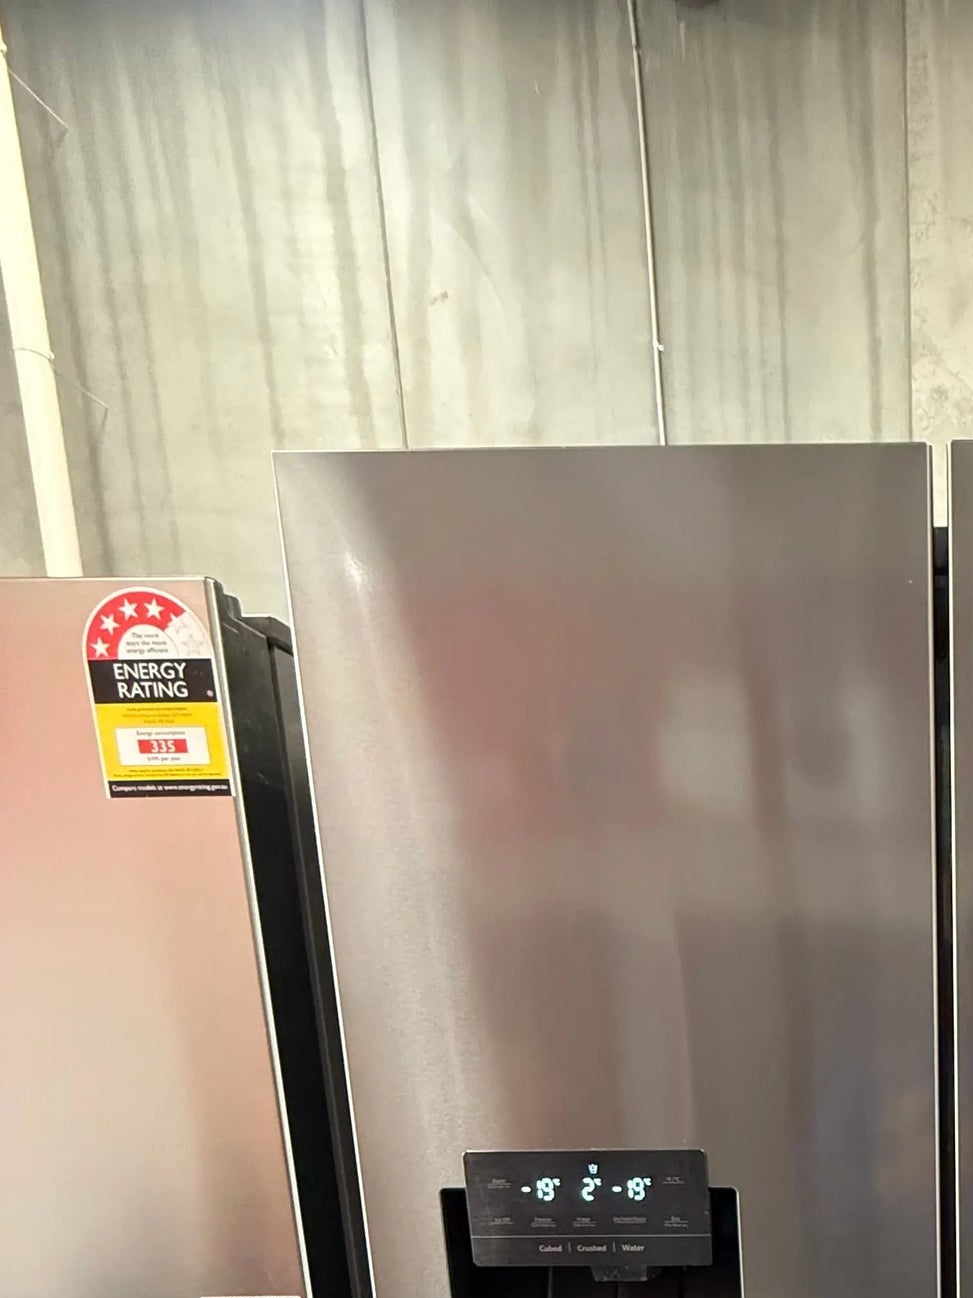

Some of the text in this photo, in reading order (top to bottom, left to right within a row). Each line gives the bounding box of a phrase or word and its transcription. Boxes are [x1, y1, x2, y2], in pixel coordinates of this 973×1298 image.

[113, 662, 186, 680] ENERGY
[117, 681, 189, 699] RATING
[150, 740, 176, 753] 335
[539, 1244, 645, 1252] Cubed Crushed Water
